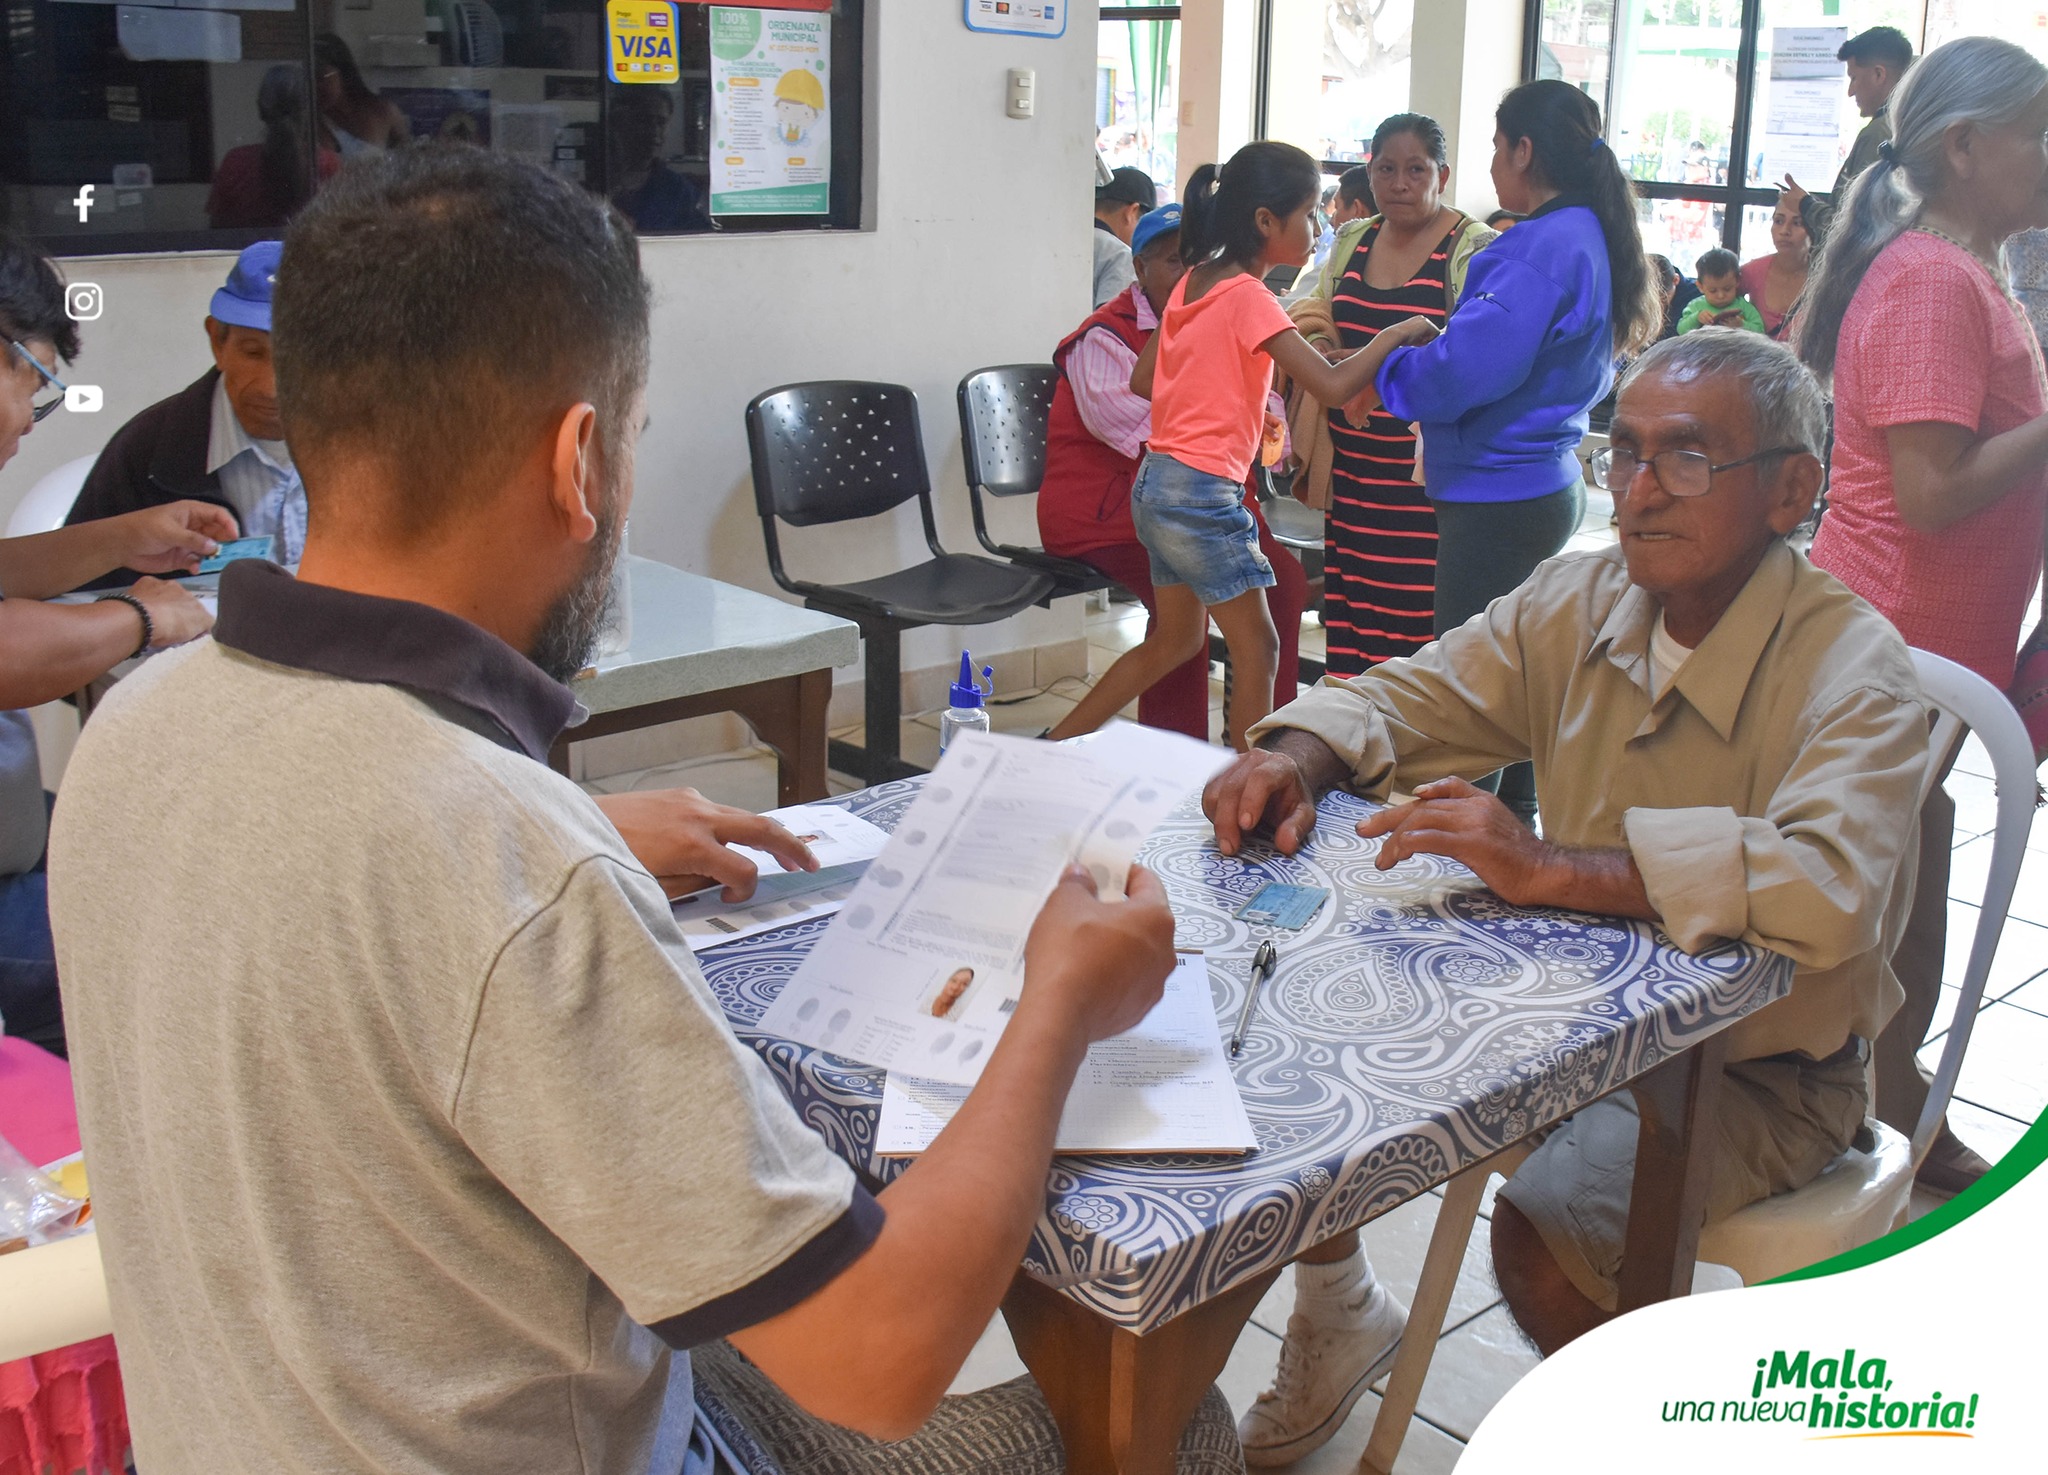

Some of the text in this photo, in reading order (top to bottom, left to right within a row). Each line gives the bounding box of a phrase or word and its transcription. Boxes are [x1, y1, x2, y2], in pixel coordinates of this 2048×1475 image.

[719, 12, 748, 26] 100%
[768, 20, 822, 32] ORDENANZA
[771, 33, 818, 43] MUNICIPAL
[615, 35, 672, 58] VISA
